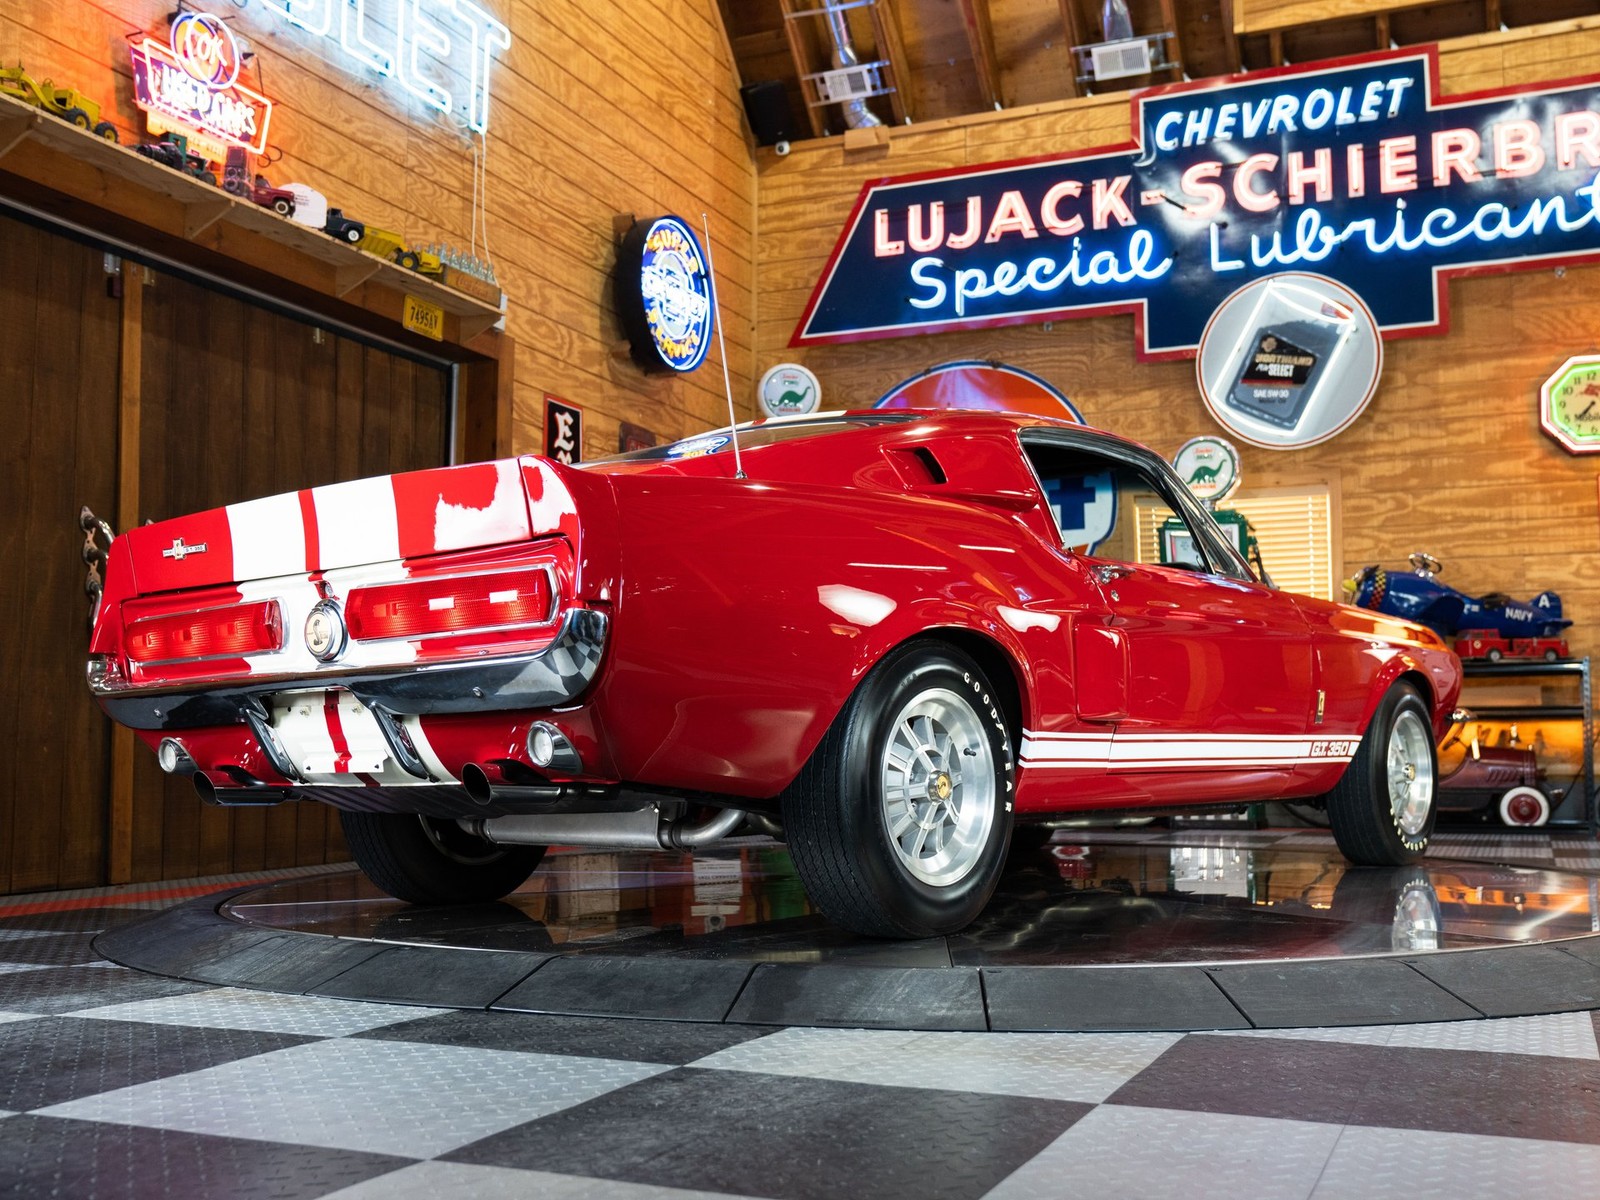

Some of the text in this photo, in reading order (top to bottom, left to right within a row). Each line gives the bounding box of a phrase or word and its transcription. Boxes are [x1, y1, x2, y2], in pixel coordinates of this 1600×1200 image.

[196, 32, 228, 66] OK
[1155, 77, 1414, 151] CHEVROLET
[906, 229, 1178, 316] Special
[1268, 364, 1294, 377] SELECT
[1587, 371, 1597, 380] 12
[1563, 387, 1573, 395] 10
[1559, 400, 1566, 408] 9
[1539, 595, 1549, 608] A
[1505, 607, 1533, 622] NAVY
[1327, 741, 1350, 756] 350
